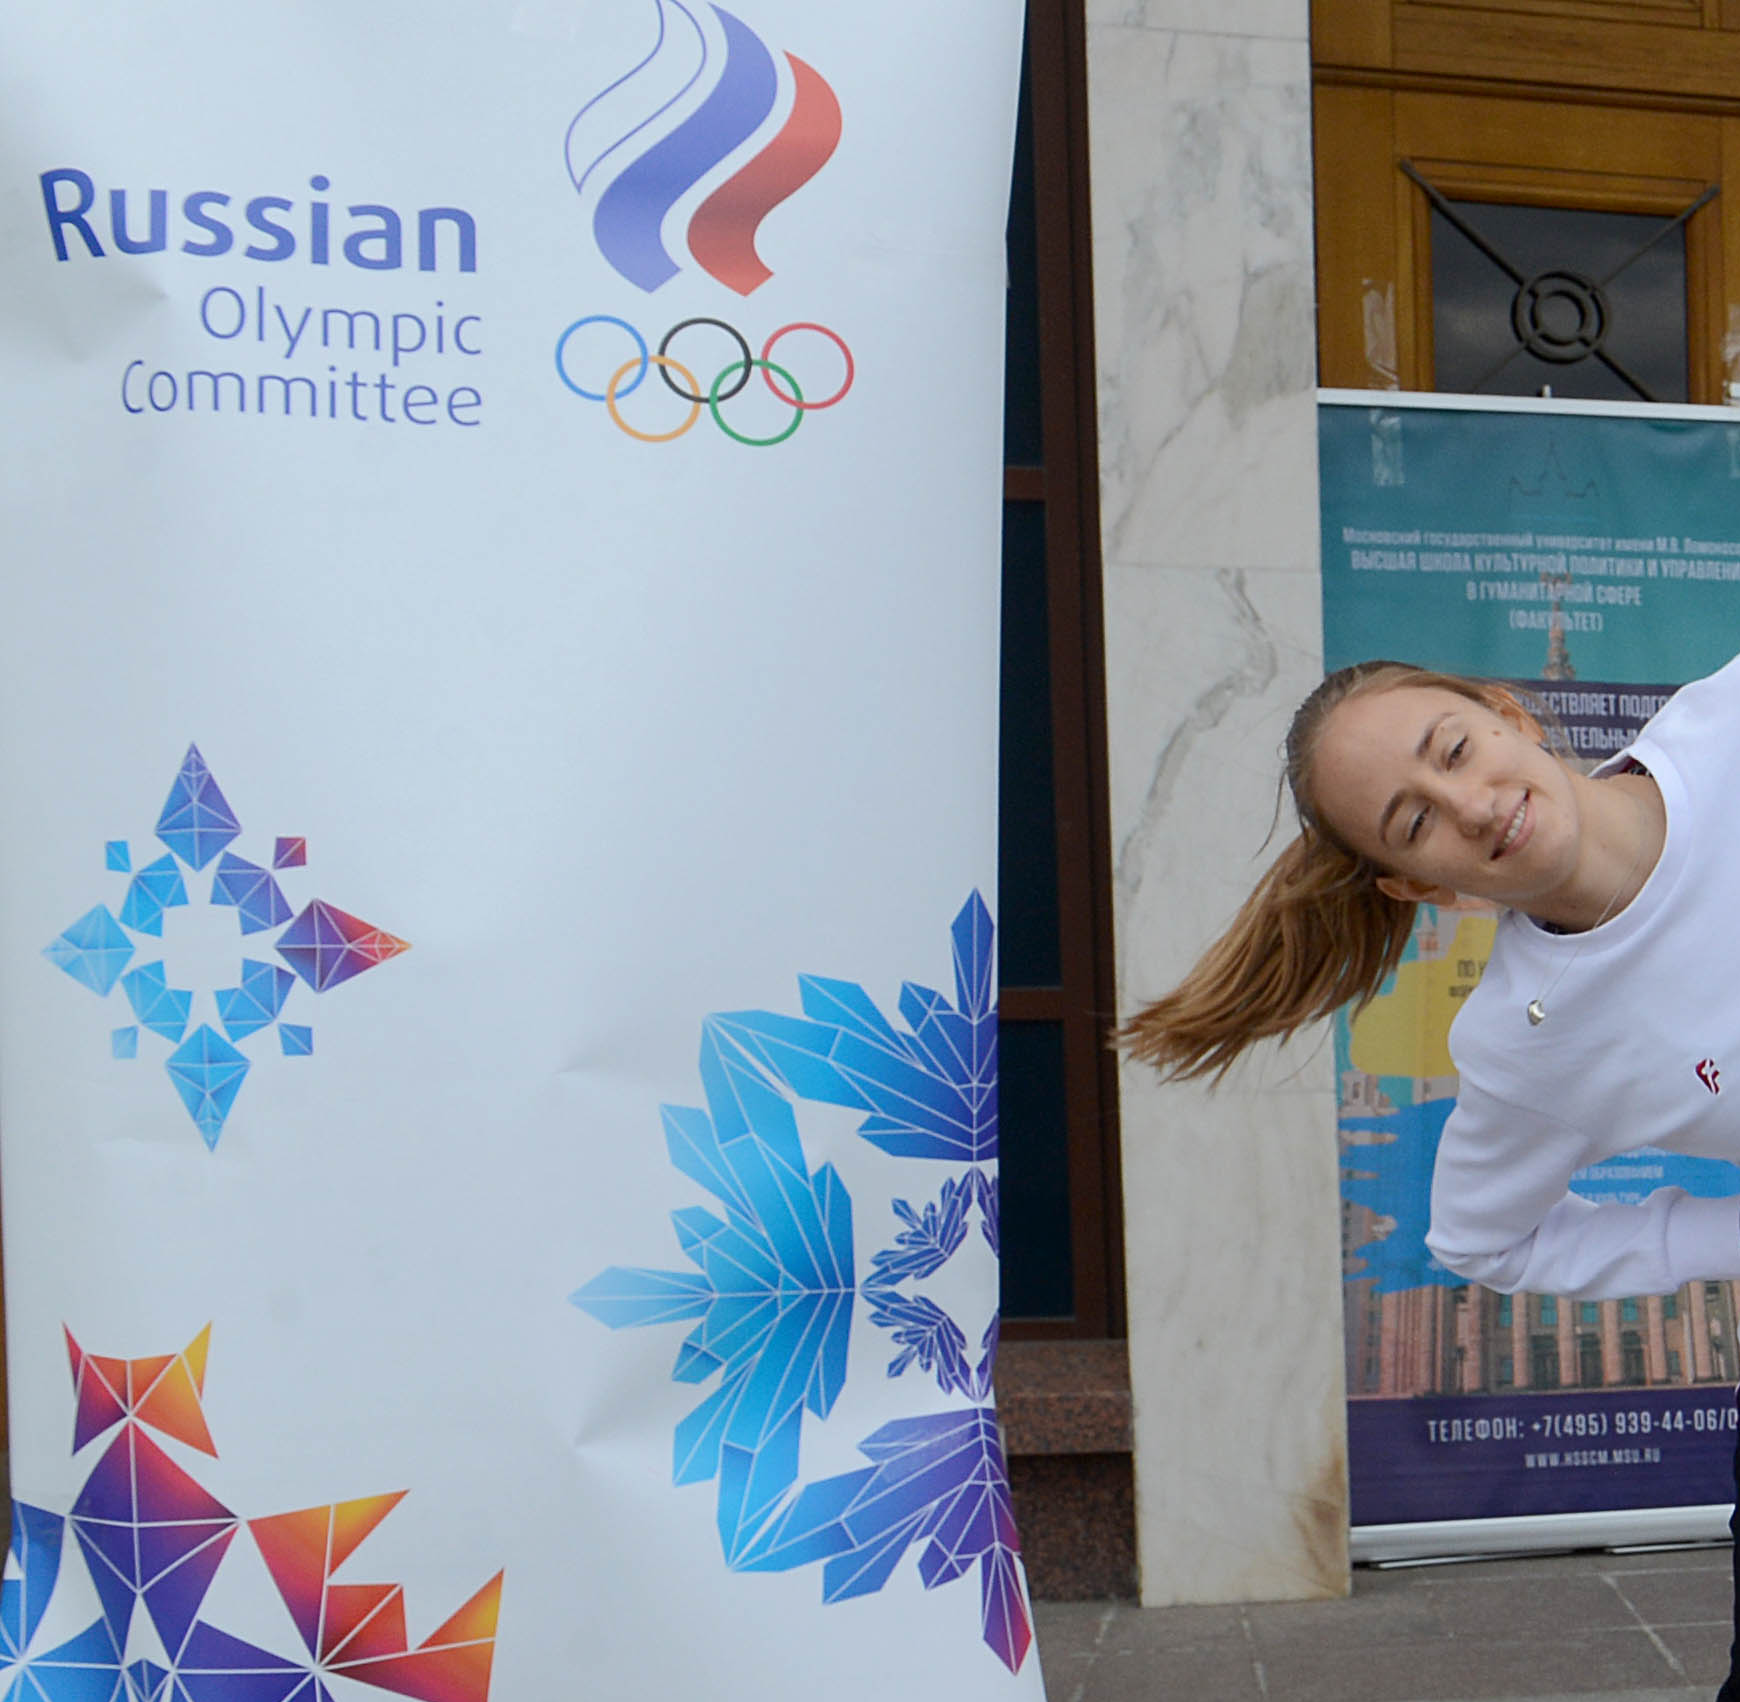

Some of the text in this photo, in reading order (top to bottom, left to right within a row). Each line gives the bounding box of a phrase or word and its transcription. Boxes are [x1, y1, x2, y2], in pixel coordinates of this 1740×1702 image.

[38, 166, 478, 274] Russian
[200, 285, 483, 366] Olympic
[121, 359, 484, 427] Committee
[1427, 1416, 1525, 1443] ТЕЛЕФОН:
[1531, 1413, 1608, 1438] +7(495)
